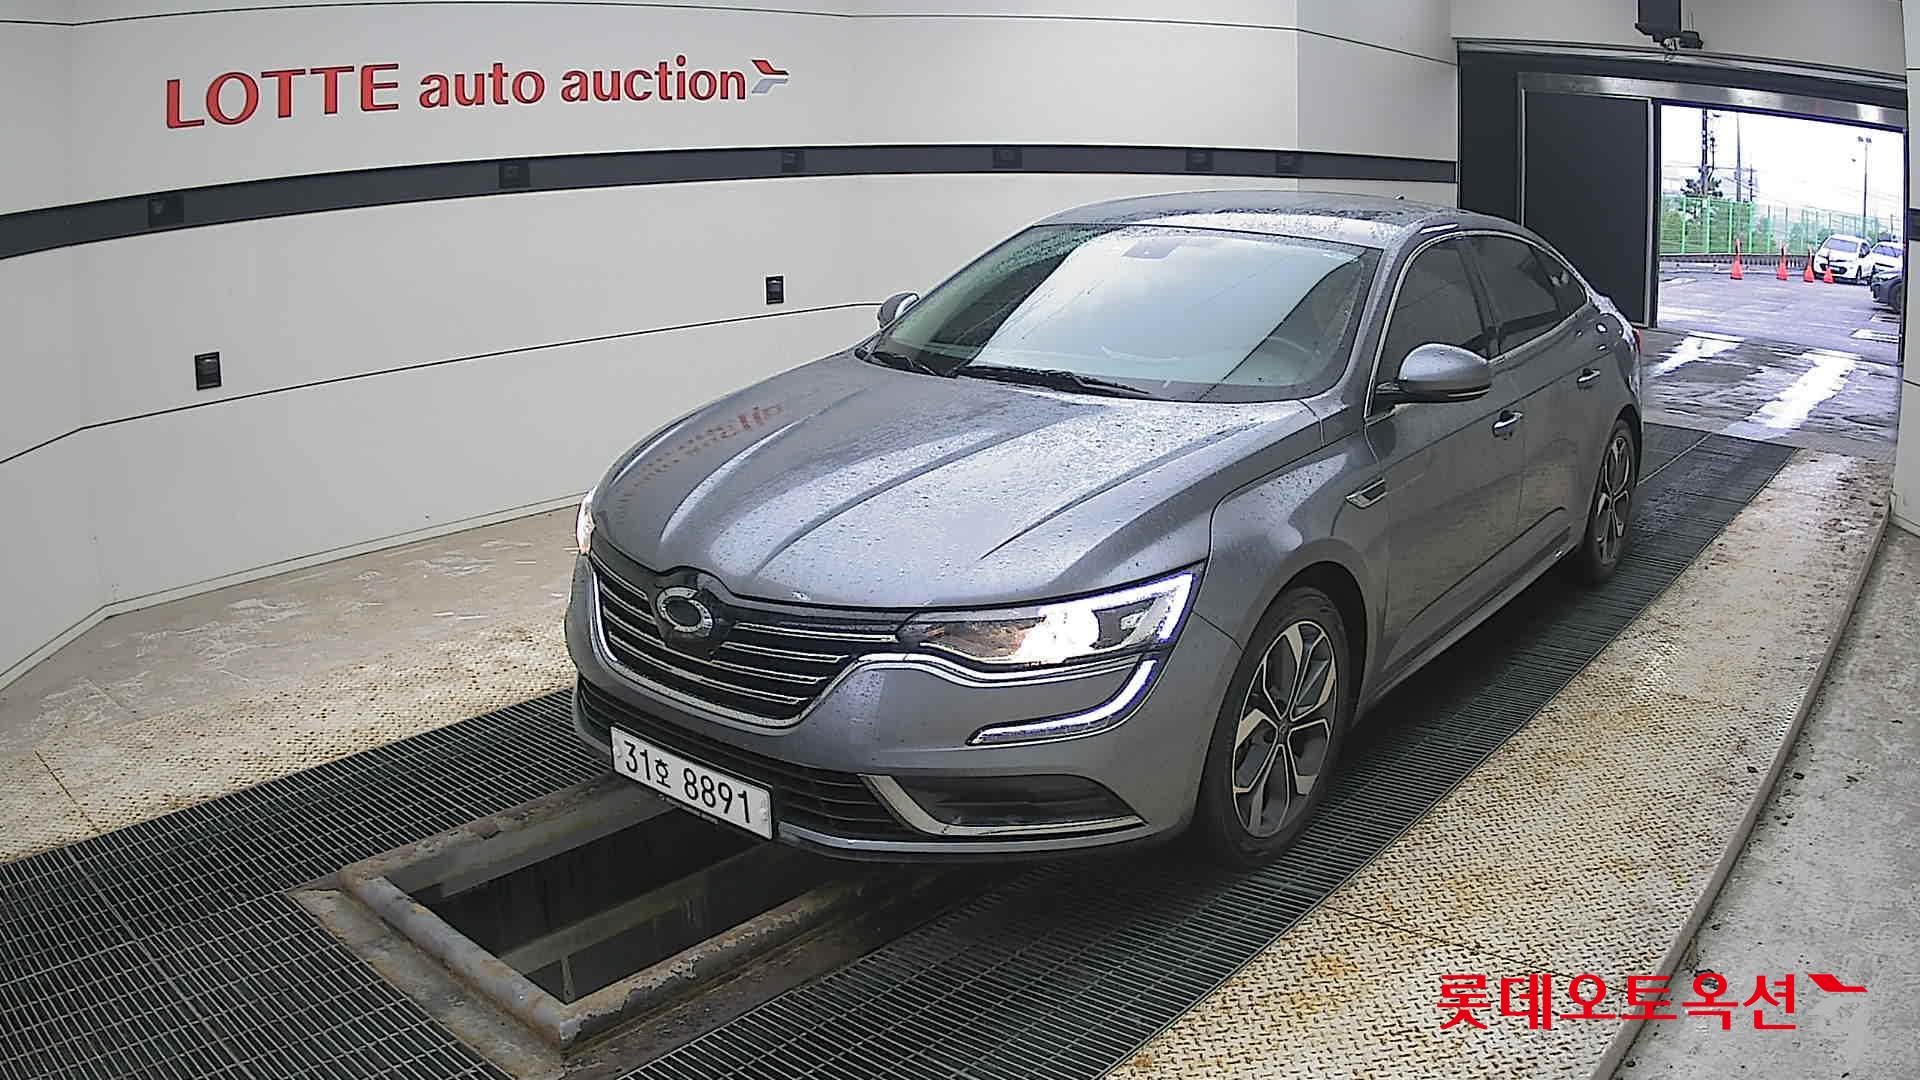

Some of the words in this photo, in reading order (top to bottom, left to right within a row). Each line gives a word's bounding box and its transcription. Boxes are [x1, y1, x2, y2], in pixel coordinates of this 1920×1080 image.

[166, 63, 399, 129] LOTTE
[419, 62, 545, 108] auto
[560, 54, 746, 102] auction
[683, 768, 750, 823] 8891
